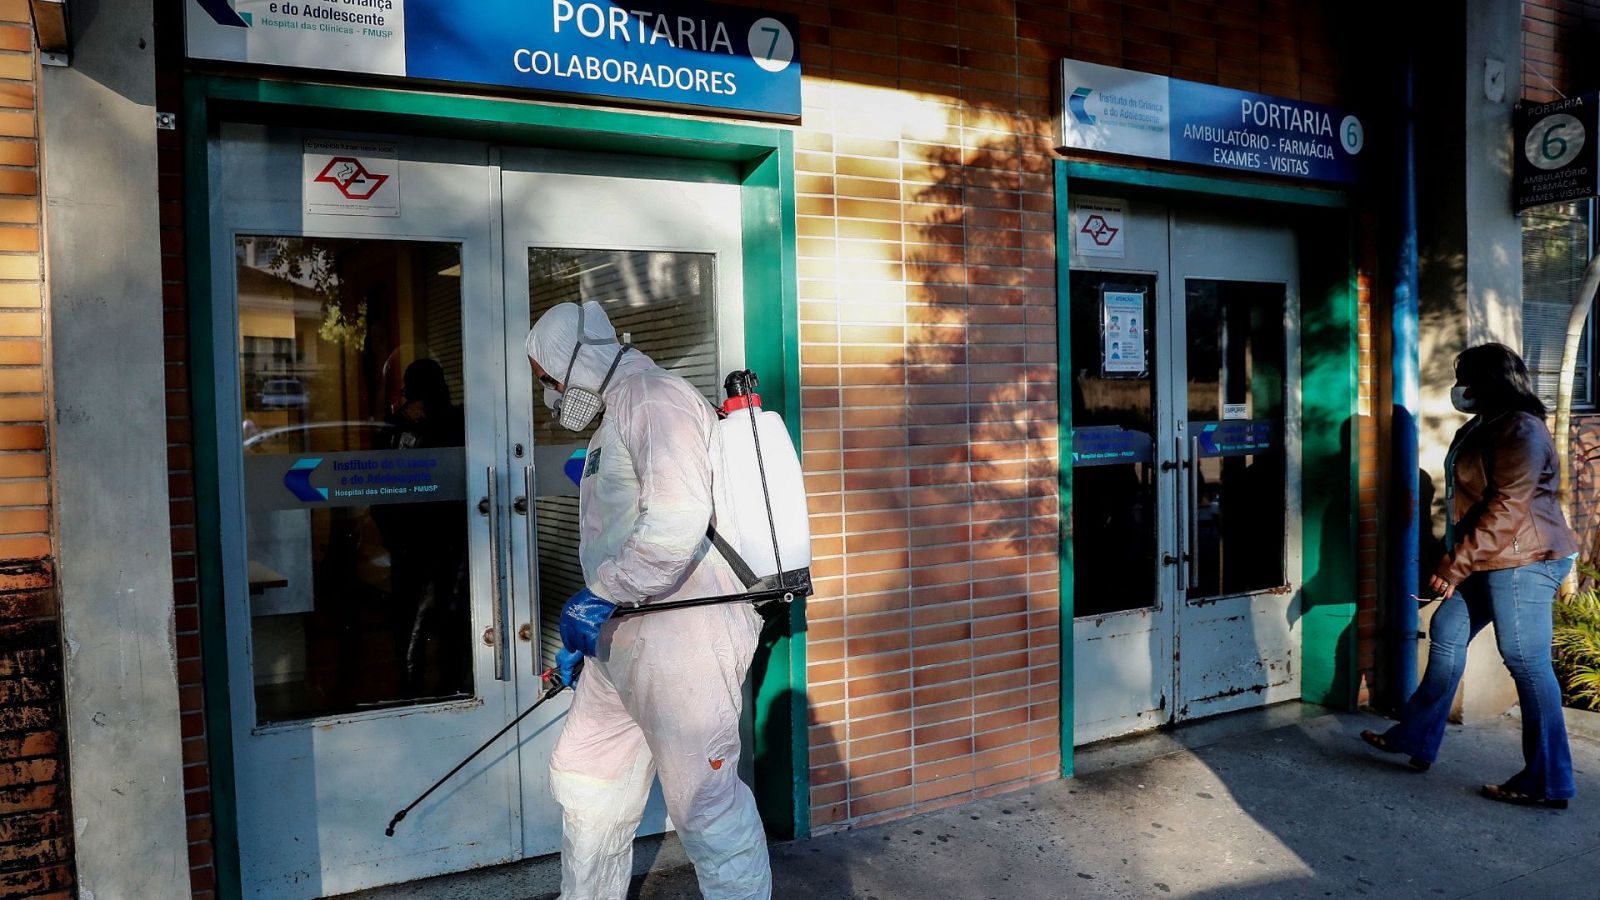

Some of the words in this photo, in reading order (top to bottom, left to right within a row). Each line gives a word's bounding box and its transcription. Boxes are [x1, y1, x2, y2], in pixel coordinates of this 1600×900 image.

[269, 3, 277, 13] e
[282, 2, 298, 15] do
[303, 4, 385, 26] Adolescente
[261, 17, 298, 29] Hospital
[300, 21, 317, 31] das
[362, 28, 393, 38] FMUSP
[553, 0, 735, 55] PORTARIA
[760, 27, 780, 61] 7
[513, 48, 737, 96] COLABORADORES
[1242, 99, 1333, 137] PORTARIA
[1528, 97, 1583, 116] PORTARIA
[1183, 123, 1269, 151] AMBULATÓRIO
[1279, 138, 1334, 160] FARMÁCIA
[1346, 122, 1357, 148] 6
[1542, 123, 1567, 160] 6
[1213, 148, 1260, 169] EXAMES
[1269, 156, 1309, 175] VISITAS
[1523, 167, 1588, 185] AMBULATÓRIO
[1532, 179, 1577, 193] FARMÁCIA
[1520, 192, 1554, 205] EXAMES
[1560, 187, 1592, 199] VISITAS
[333, 459, 378, 471] Instituto
[350, 474, 364, 485] do
[334, 488, 364, 497] Hospital
[365, 487, 378, 495] das
